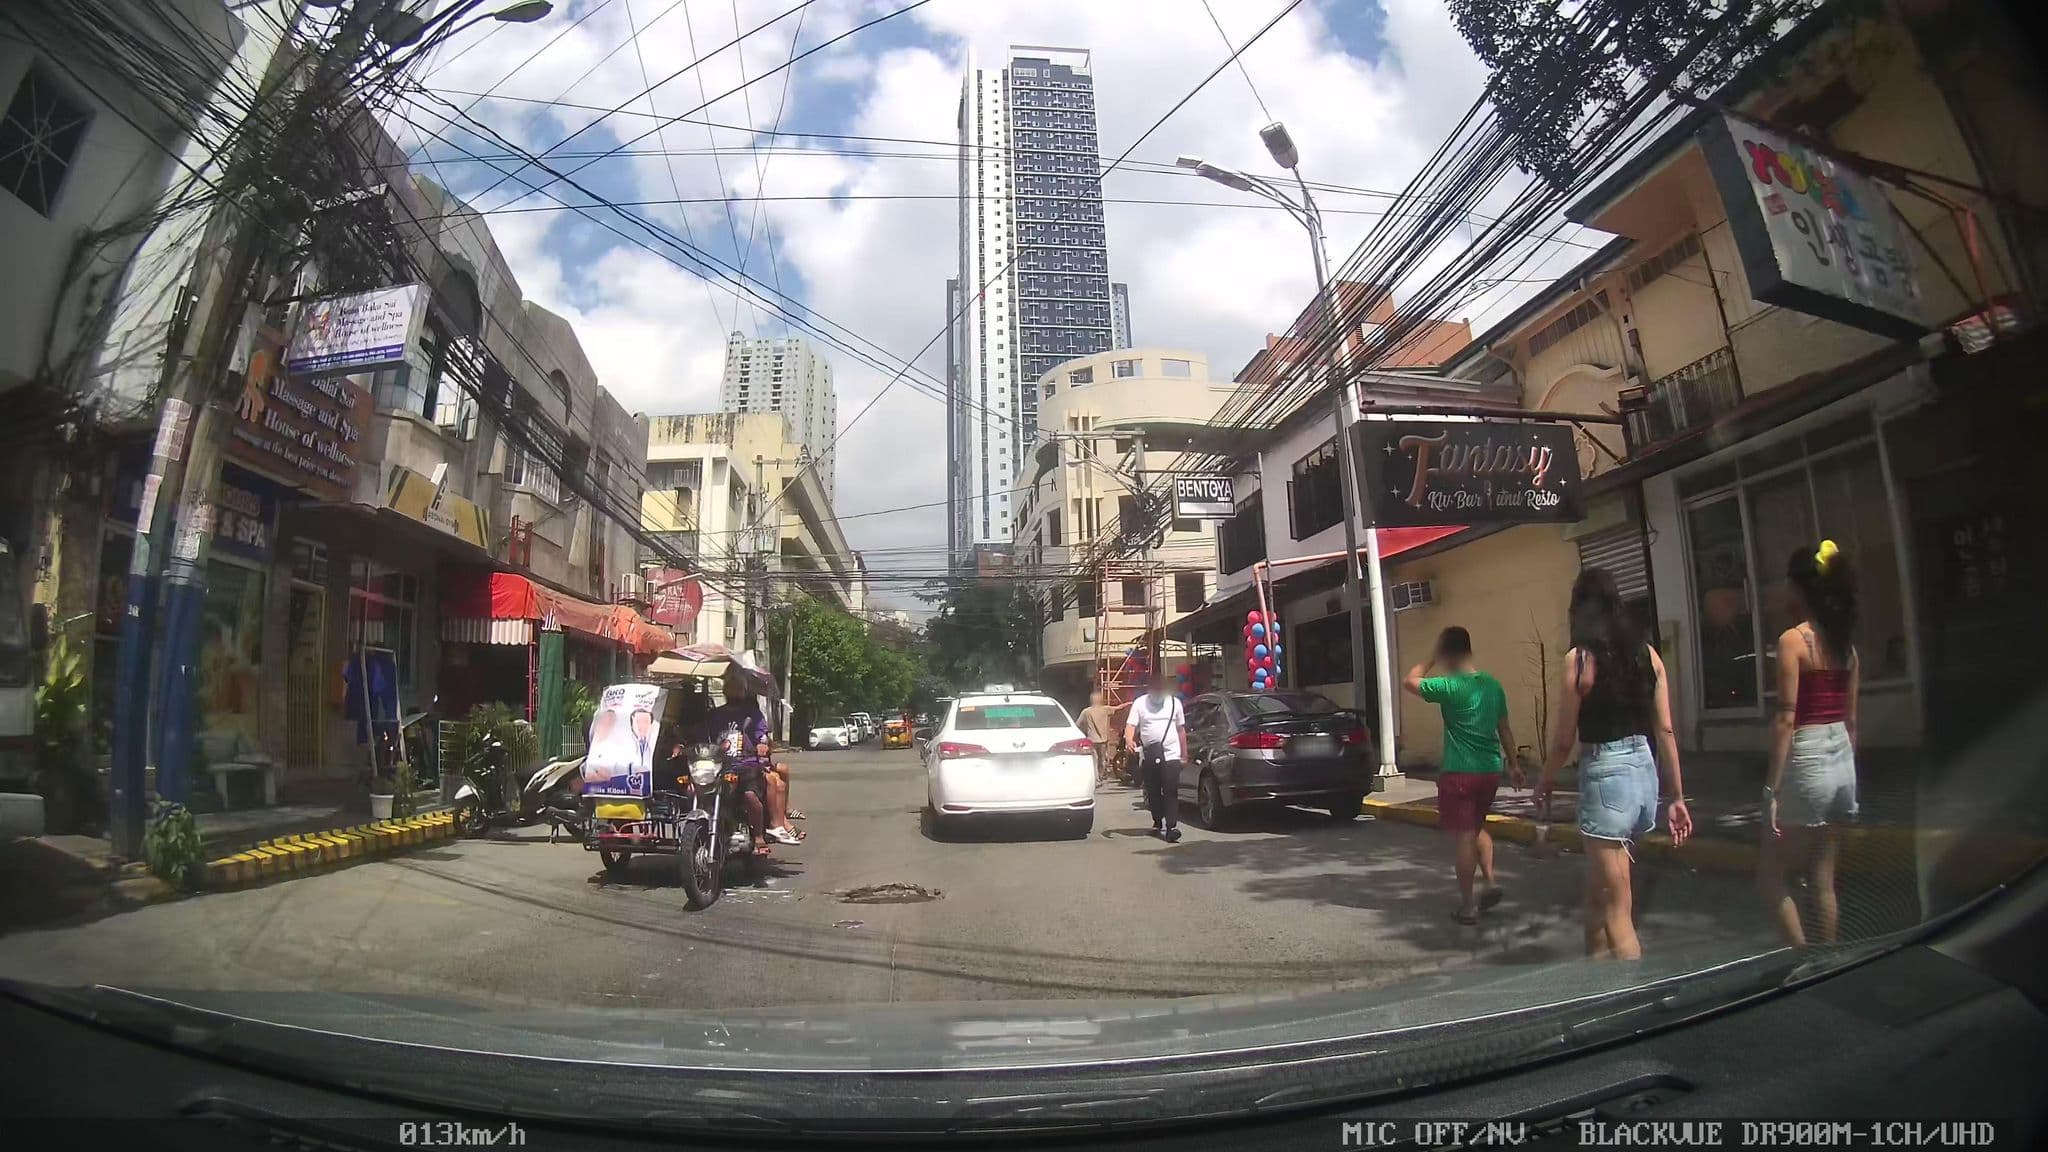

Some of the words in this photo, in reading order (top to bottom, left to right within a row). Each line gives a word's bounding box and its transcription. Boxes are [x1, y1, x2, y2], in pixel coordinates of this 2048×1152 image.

[370, 312, 386, 322] and
[271, 376, 317, 419] Massage
[317, 408, 340, 431] and
[340, 416, 360, 442] Spa
[264, 407, 301, 441] House
[301, 431, 318, 449] of
[317, 441, 356, 466] wellness
[271, 441, 283, 455] the
[1399, 430, 1553, 505] Fantasy
[1177, 479, 1233, 499] BENTOYA
[1524, 489, 1560, 511] Resto
[238, 517, 266, 549] SPA
